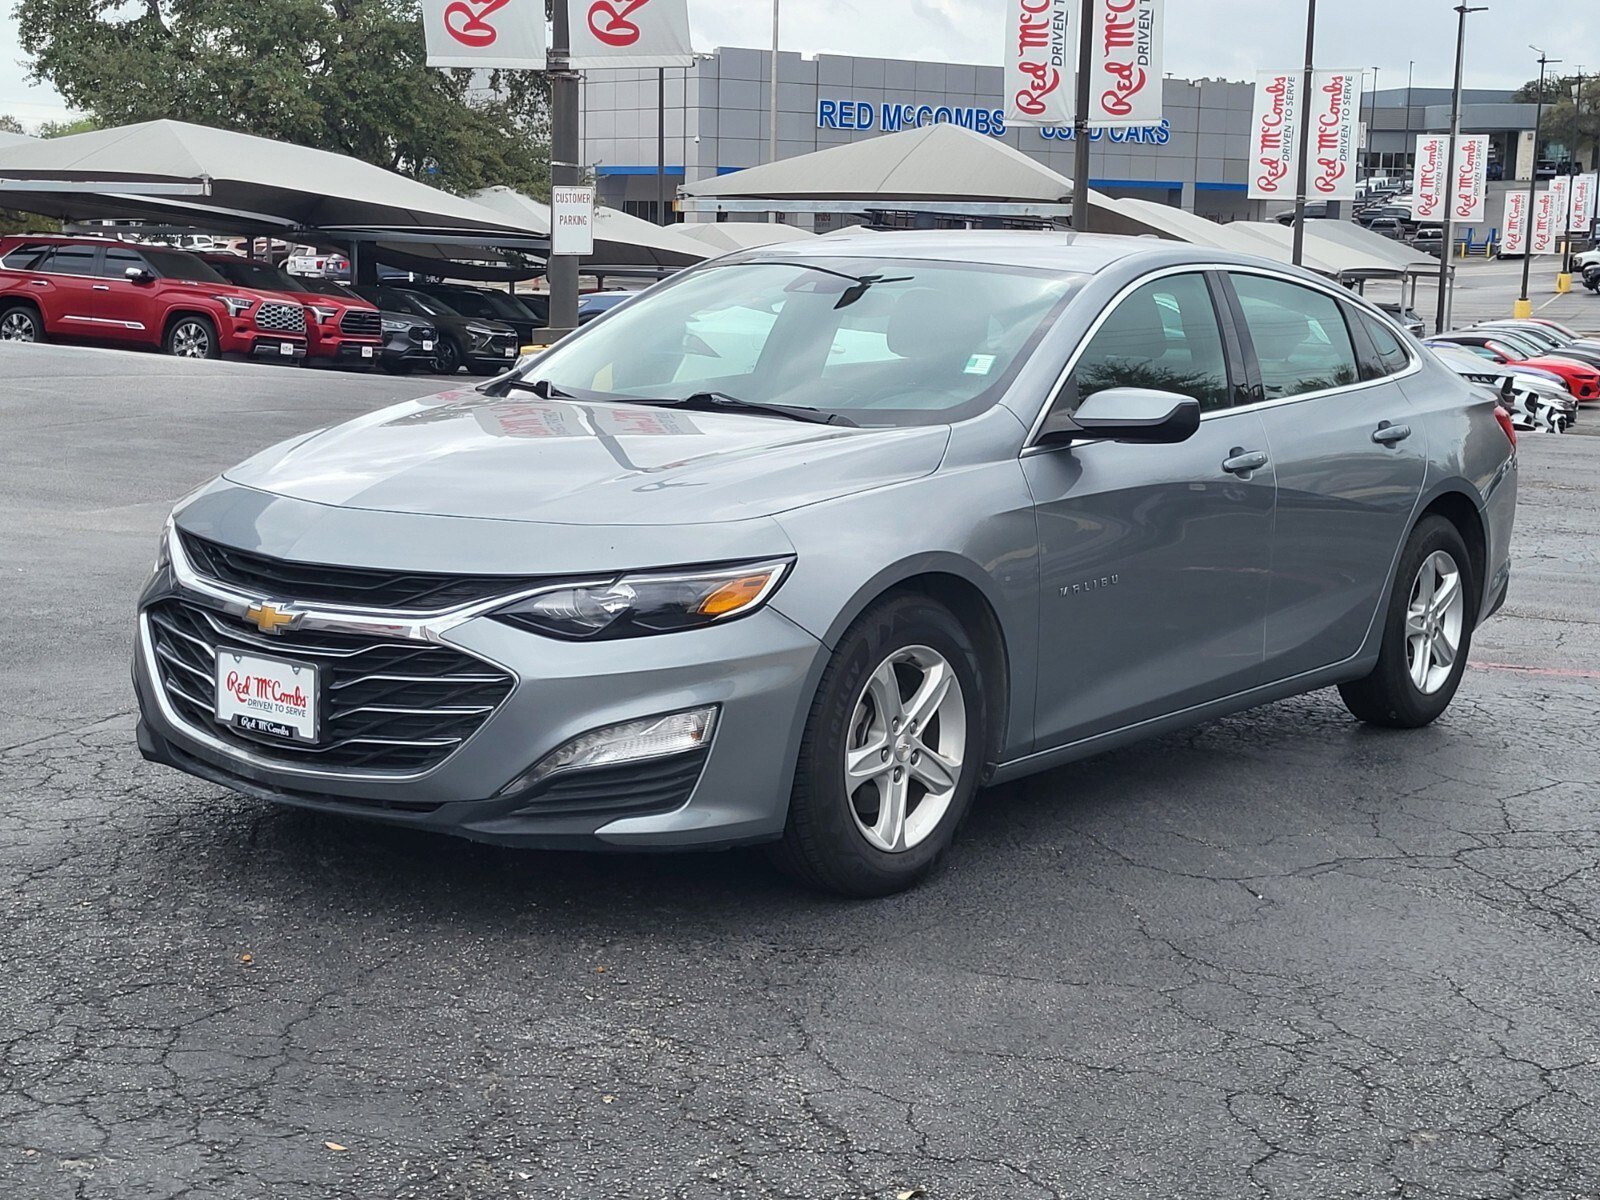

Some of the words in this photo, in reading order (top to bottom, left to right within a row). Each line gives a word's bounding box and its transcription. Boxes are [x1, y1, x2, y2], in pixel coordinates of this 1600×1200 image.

[1051, 10, 1065, 66] DRIVEN
[1137, 9, 1151, 66] DRIVEN
[1015, 61, 1059, 115] Red
[1101, 61, 1146, 115] Red
[1286, 76, 1296, 106] SERVE
[1343, 75, 1353, 105] SERVE
[817, 100, 875, 130] RED
[1260, 76, 1287, 154] McCombs
[1284, 108, 1293, 121] TO
[1317, 75, 1344, 154] McCombs
[1341, 108, 1350, 121] TO
[1109, 119, 1170, 145] CARS
[1282, 125, 1292, 161] DRIVEN
[1339, 124, 1349, 161] DRIVEN
[1257, 157, 1288, 192] Red
[1314, 158, 1345, 193] Red
[1421, 140, 1438, 191] McCombs
[1436, 161, 1443, 170] TO
[1459, 140, 1476, 191] McCombs
[1475, 161, 1481, 170] TO
[555, 192, 591, 204] CUSTOMER
[1417, 193, 1438, 216] Red
[1456, 193, 1477, 217] Red
[559, 215, 587, 226] PARKING
[1059, 574, 1119, 597] MALIBU
[227, 671, 250, 703] Red
[253, 676, 307, 708] McCombs
[241, 716, 256, 729] Red
[247, 698, 273, 711] DRIVEN
[274, 703, 285, 713] TO
[285, 706, 307, 718] SERVE
